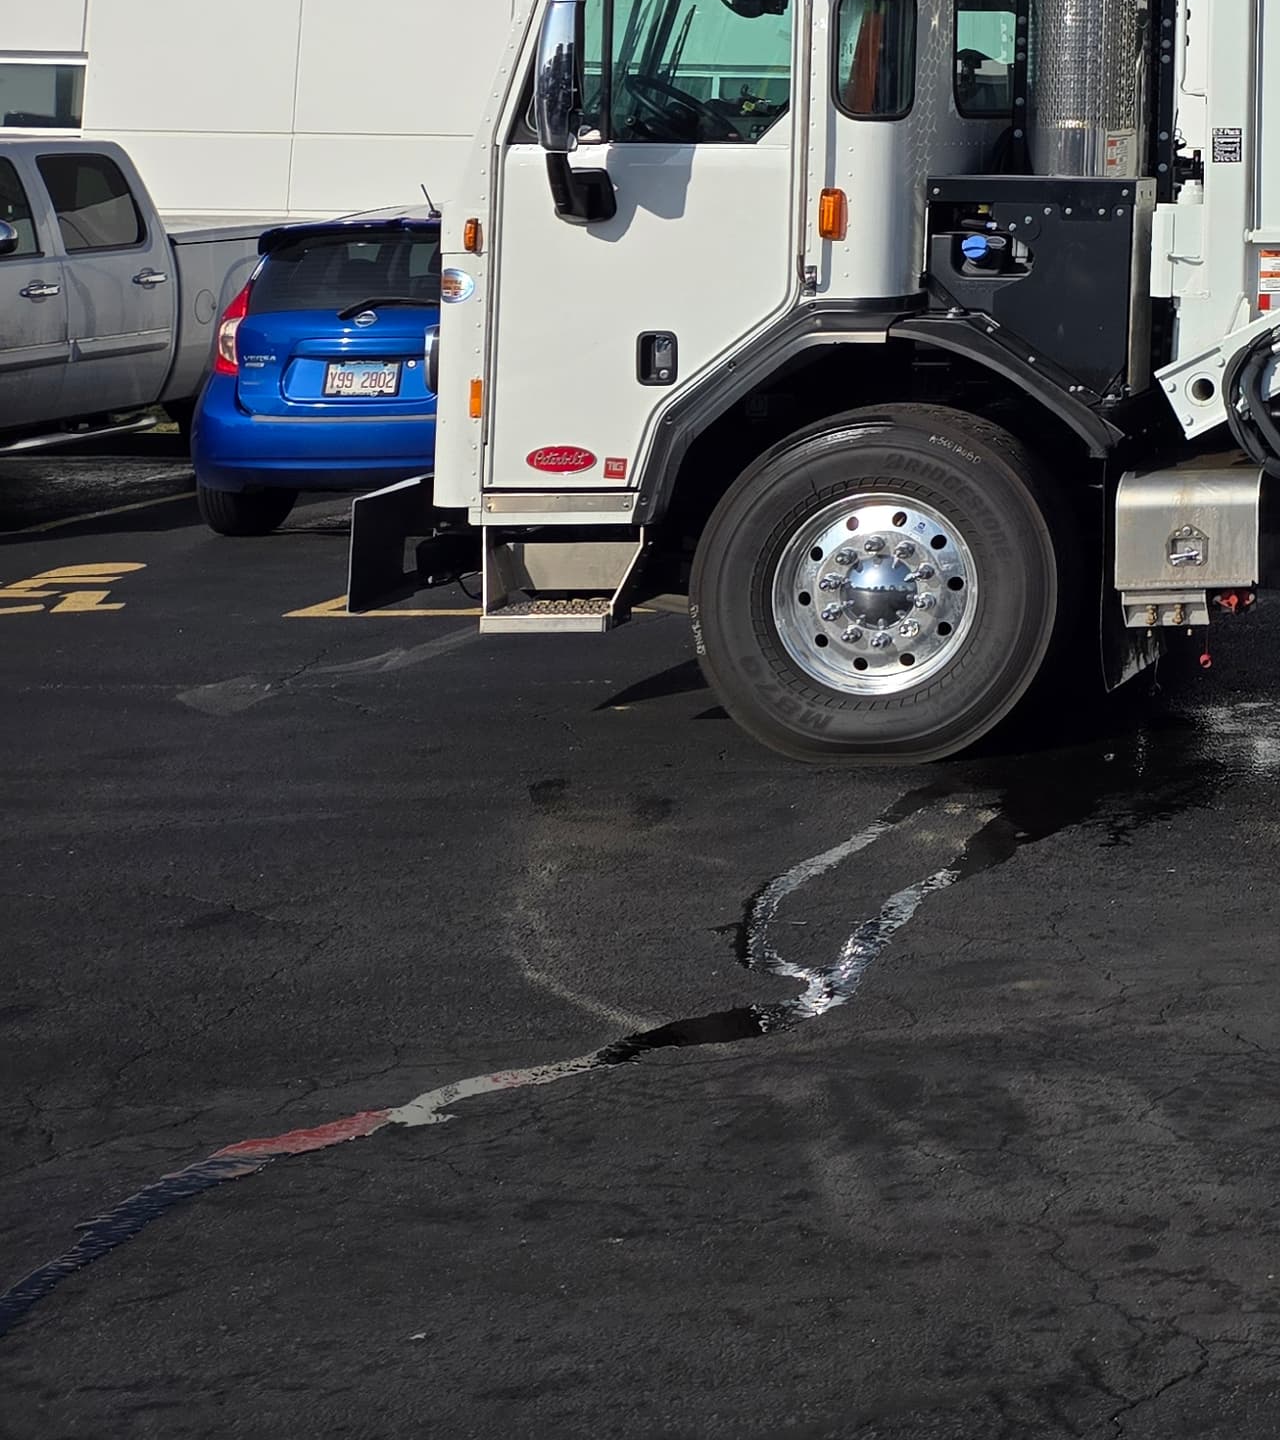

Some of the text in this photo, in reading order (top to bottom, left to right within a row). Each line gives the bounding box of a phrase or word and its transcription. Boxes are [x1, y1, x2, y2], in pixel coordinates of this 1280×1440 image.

[329, 371, 396, 389] Y99 2802
[534, 450, 590, 466] Peterbilt
[885, 453, 1010, 558] BRIDGESTONE
